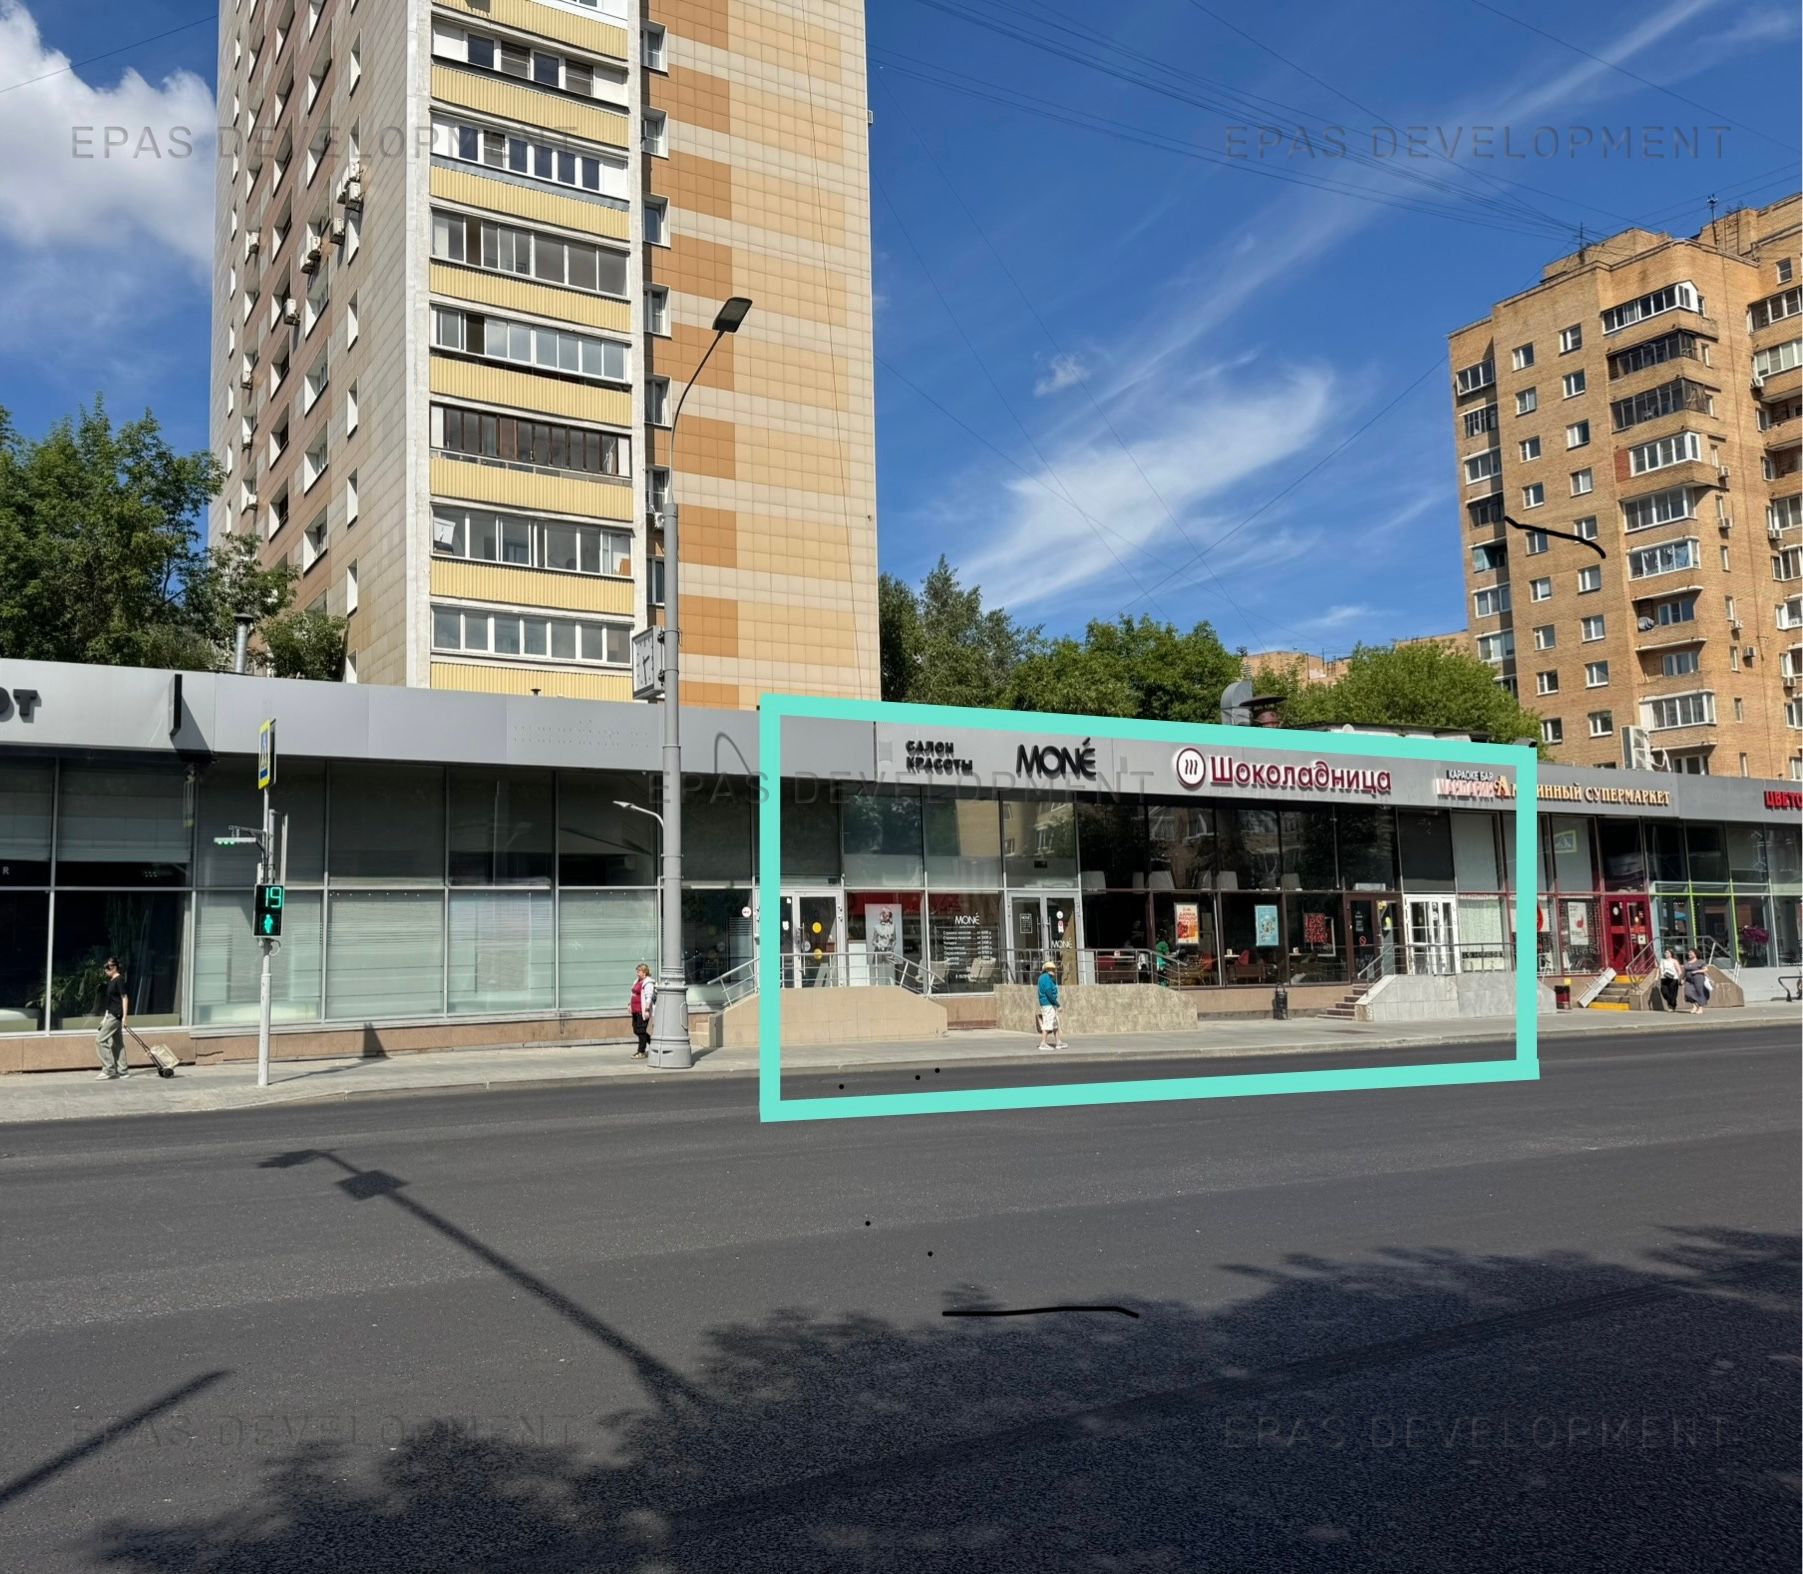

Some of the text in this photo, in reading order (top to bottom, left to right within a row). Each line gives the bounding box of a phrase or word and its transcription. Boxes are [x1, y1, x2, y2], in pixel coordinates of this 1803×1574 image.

[905, 740, 955, 758] САЛОН
[1016, 736, 1097, 780] MONÉ
[905, 756, 974, 776] КРАСОТЫ
[1447, 769, 1494, 782] КАРАОКЕ БАР
[1210, 756, 1393, 797] Шоколадница
[1584, 786, 1671, 806] СУПЕРМАРКЕТ
[265, 886, 282, 908] 19
[955, 912, 981, 925] MONÉ
